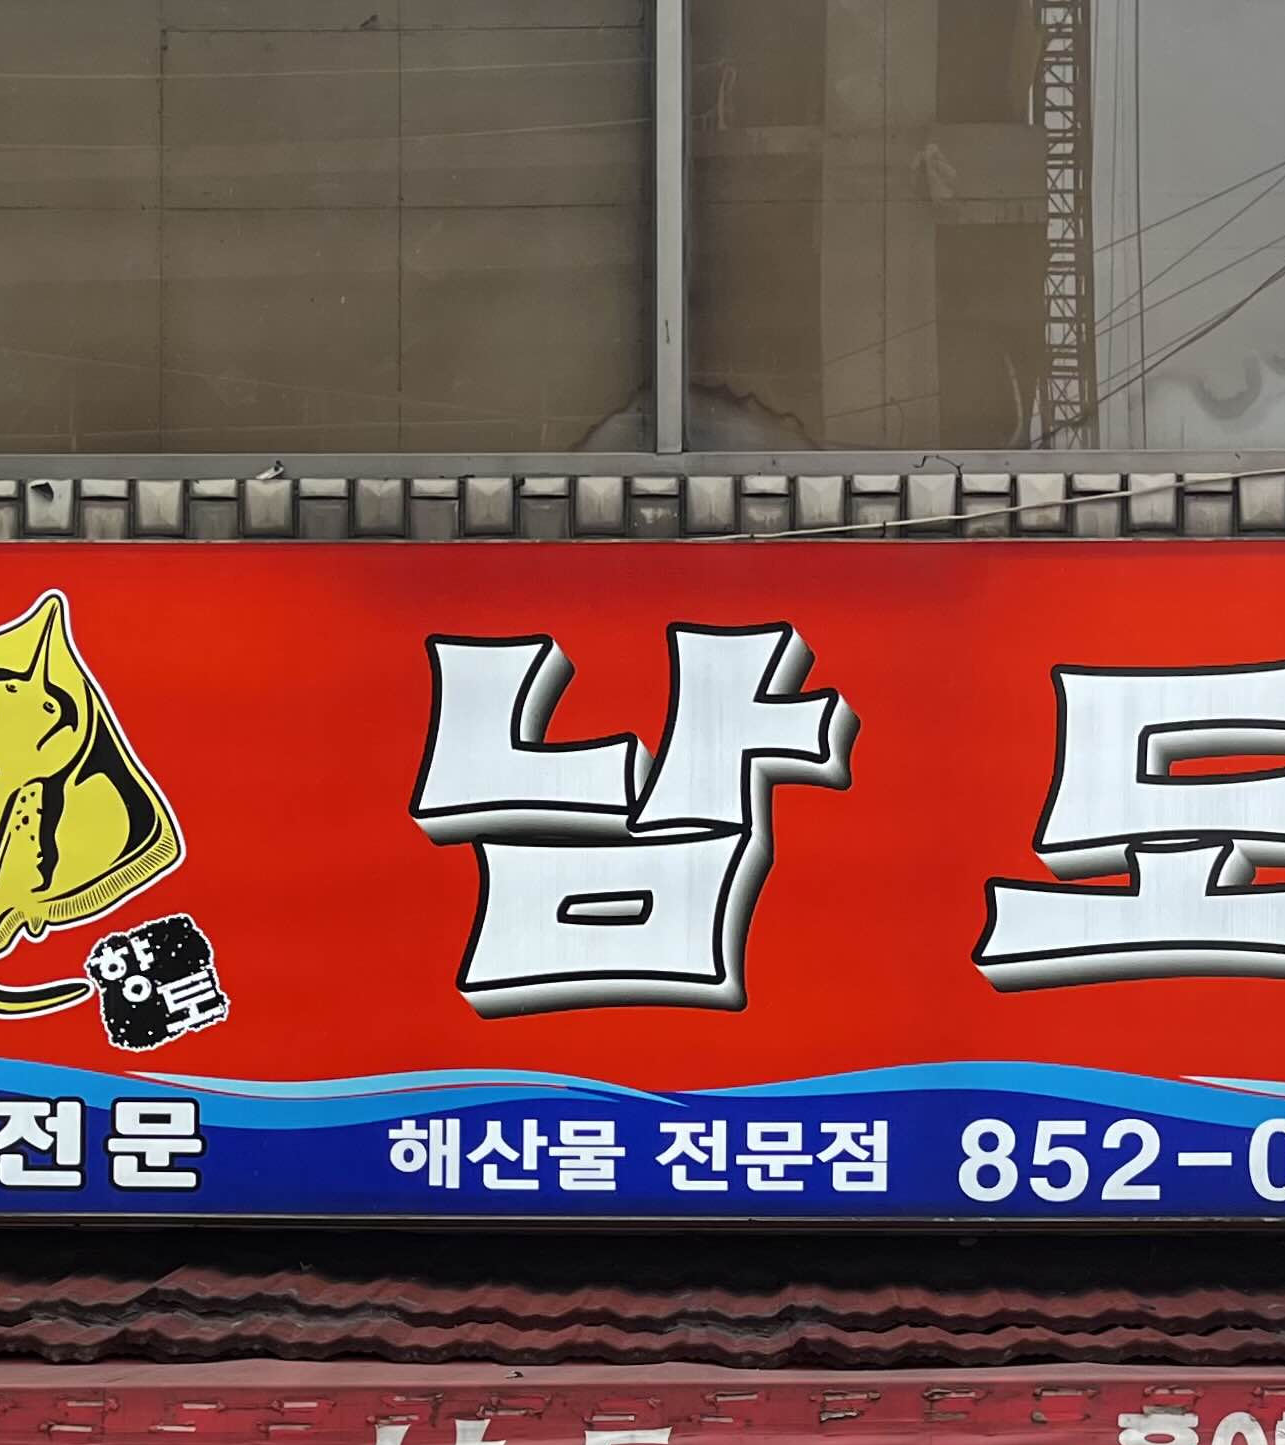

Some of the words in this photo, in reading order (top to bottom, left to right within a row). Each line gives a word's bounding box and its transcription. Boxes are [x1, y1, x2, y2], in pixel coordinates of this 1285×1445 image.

[91, 933, 228, 1035] 향토
[388, 1118, 626, 1192] 해산물
[654, 1118, 889, 1193] 전문점
